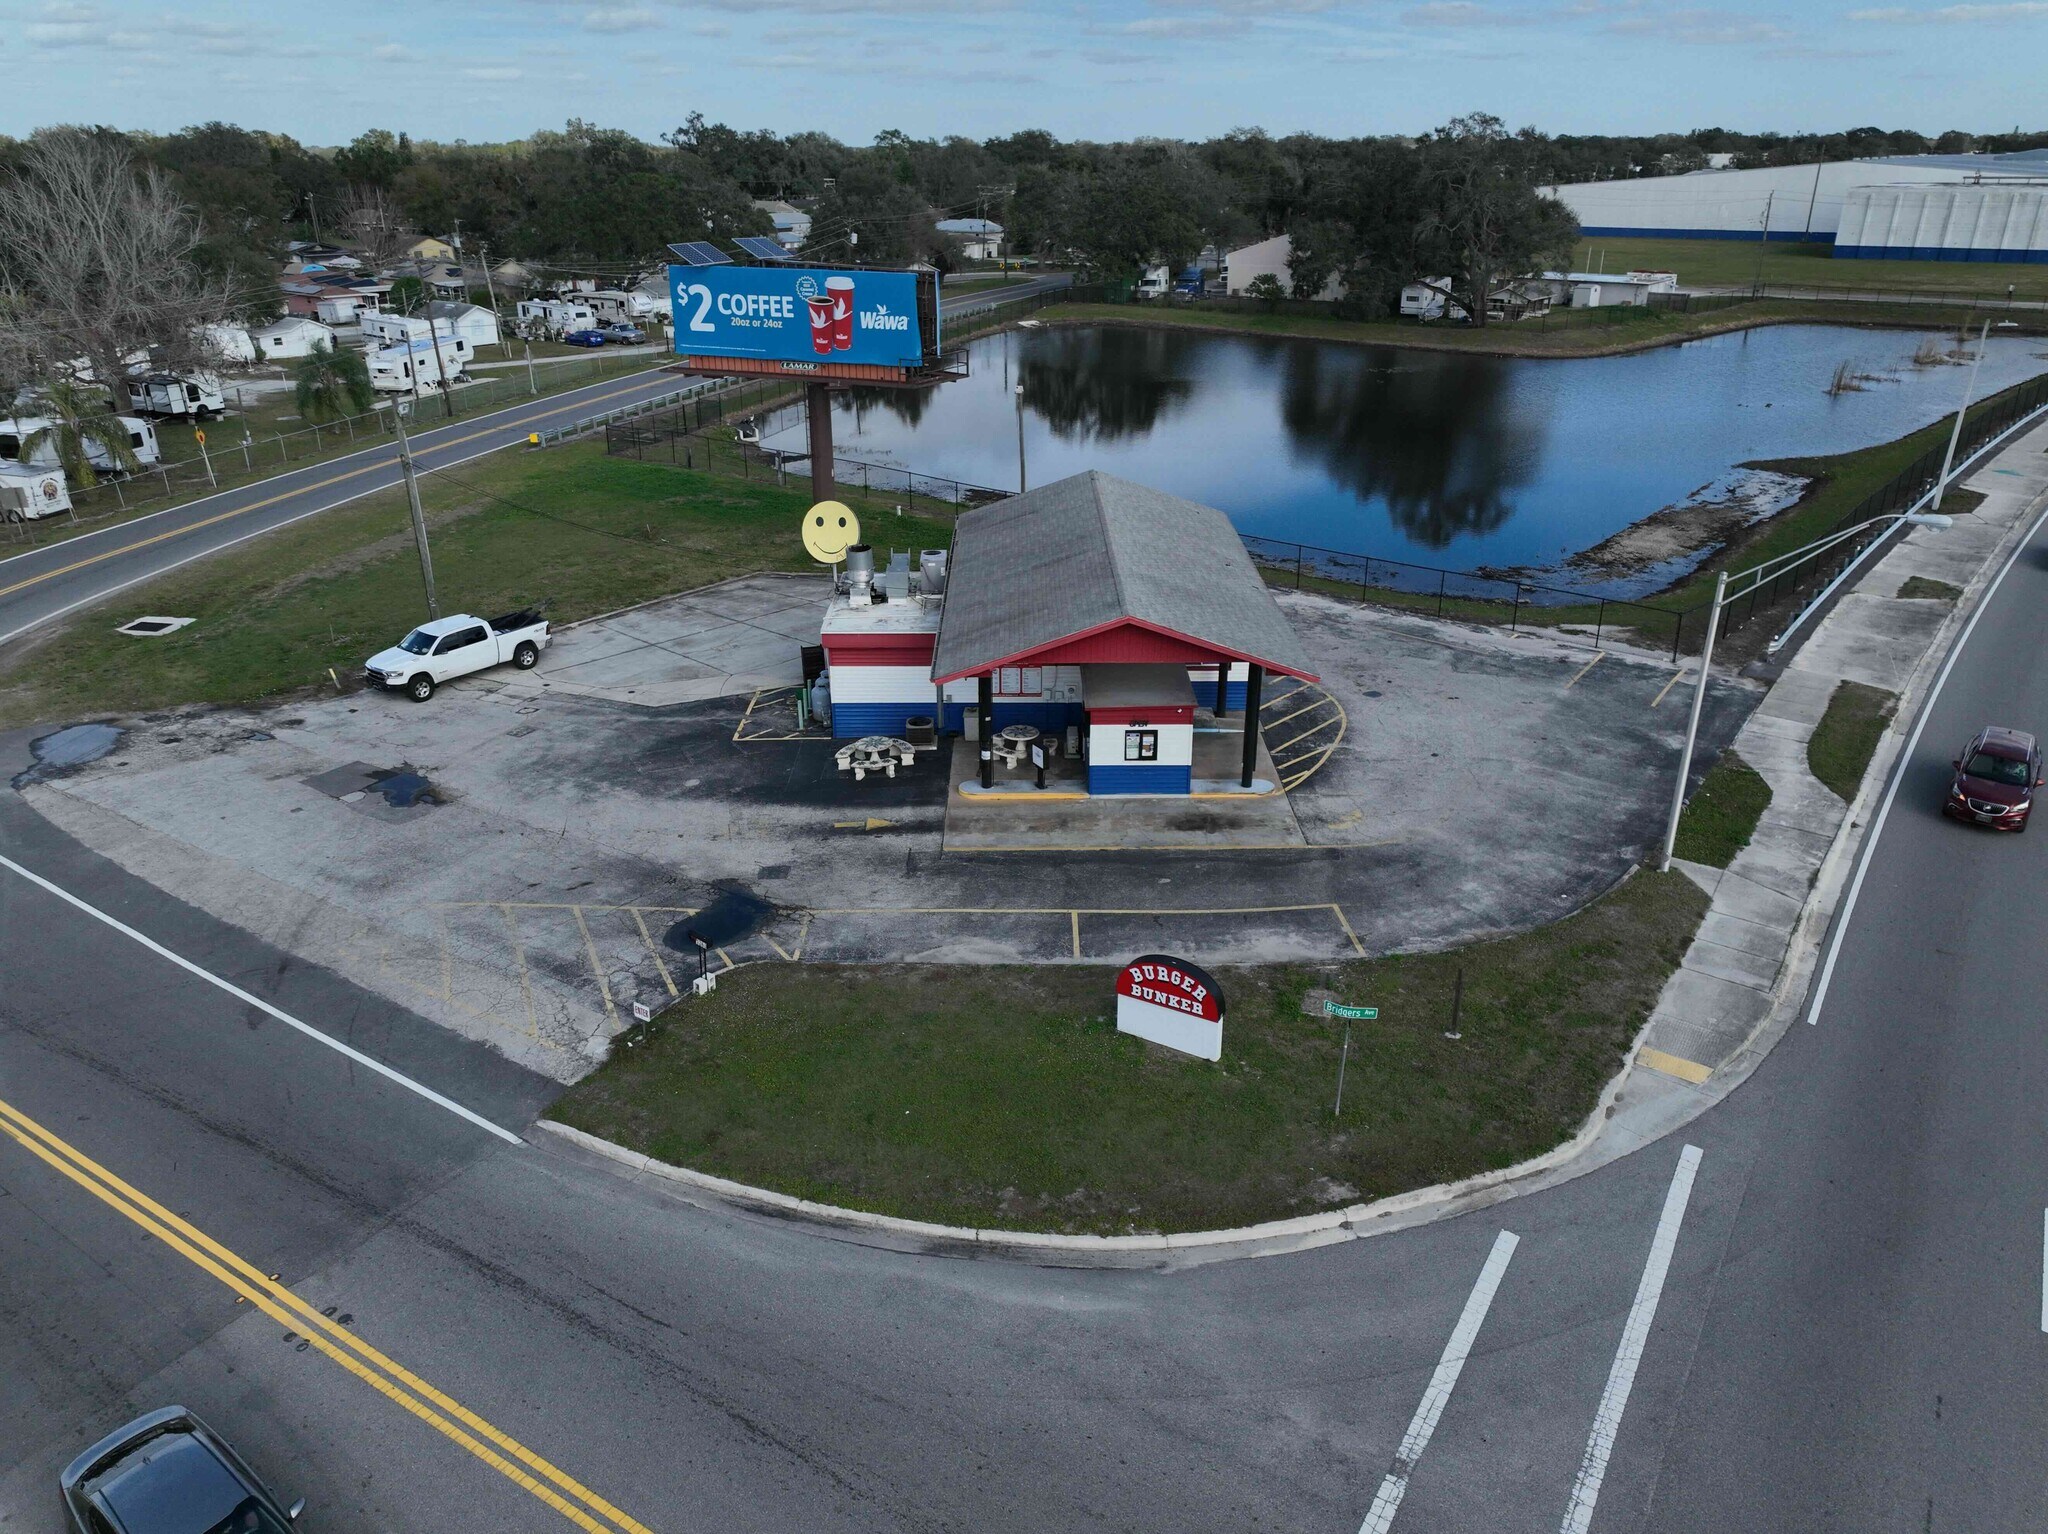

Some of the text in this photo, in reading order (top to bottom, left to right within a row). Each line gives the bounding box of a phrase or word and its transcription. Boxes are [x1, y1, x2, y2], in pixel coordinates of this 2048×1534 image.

[677, 282, 795, 332] $2 COFFEE
[731, 317, 783, 328] 20oz or 24oz
[860, 311, 908, 331] Wawa
[1129, 965, 1207, 1002] BURGER
[1131, 983, 1203, 1015] BUNKER
[635, 1005, 649, 1018] ENTER
[1326, 1002, 1361, 1017] Bridgers
